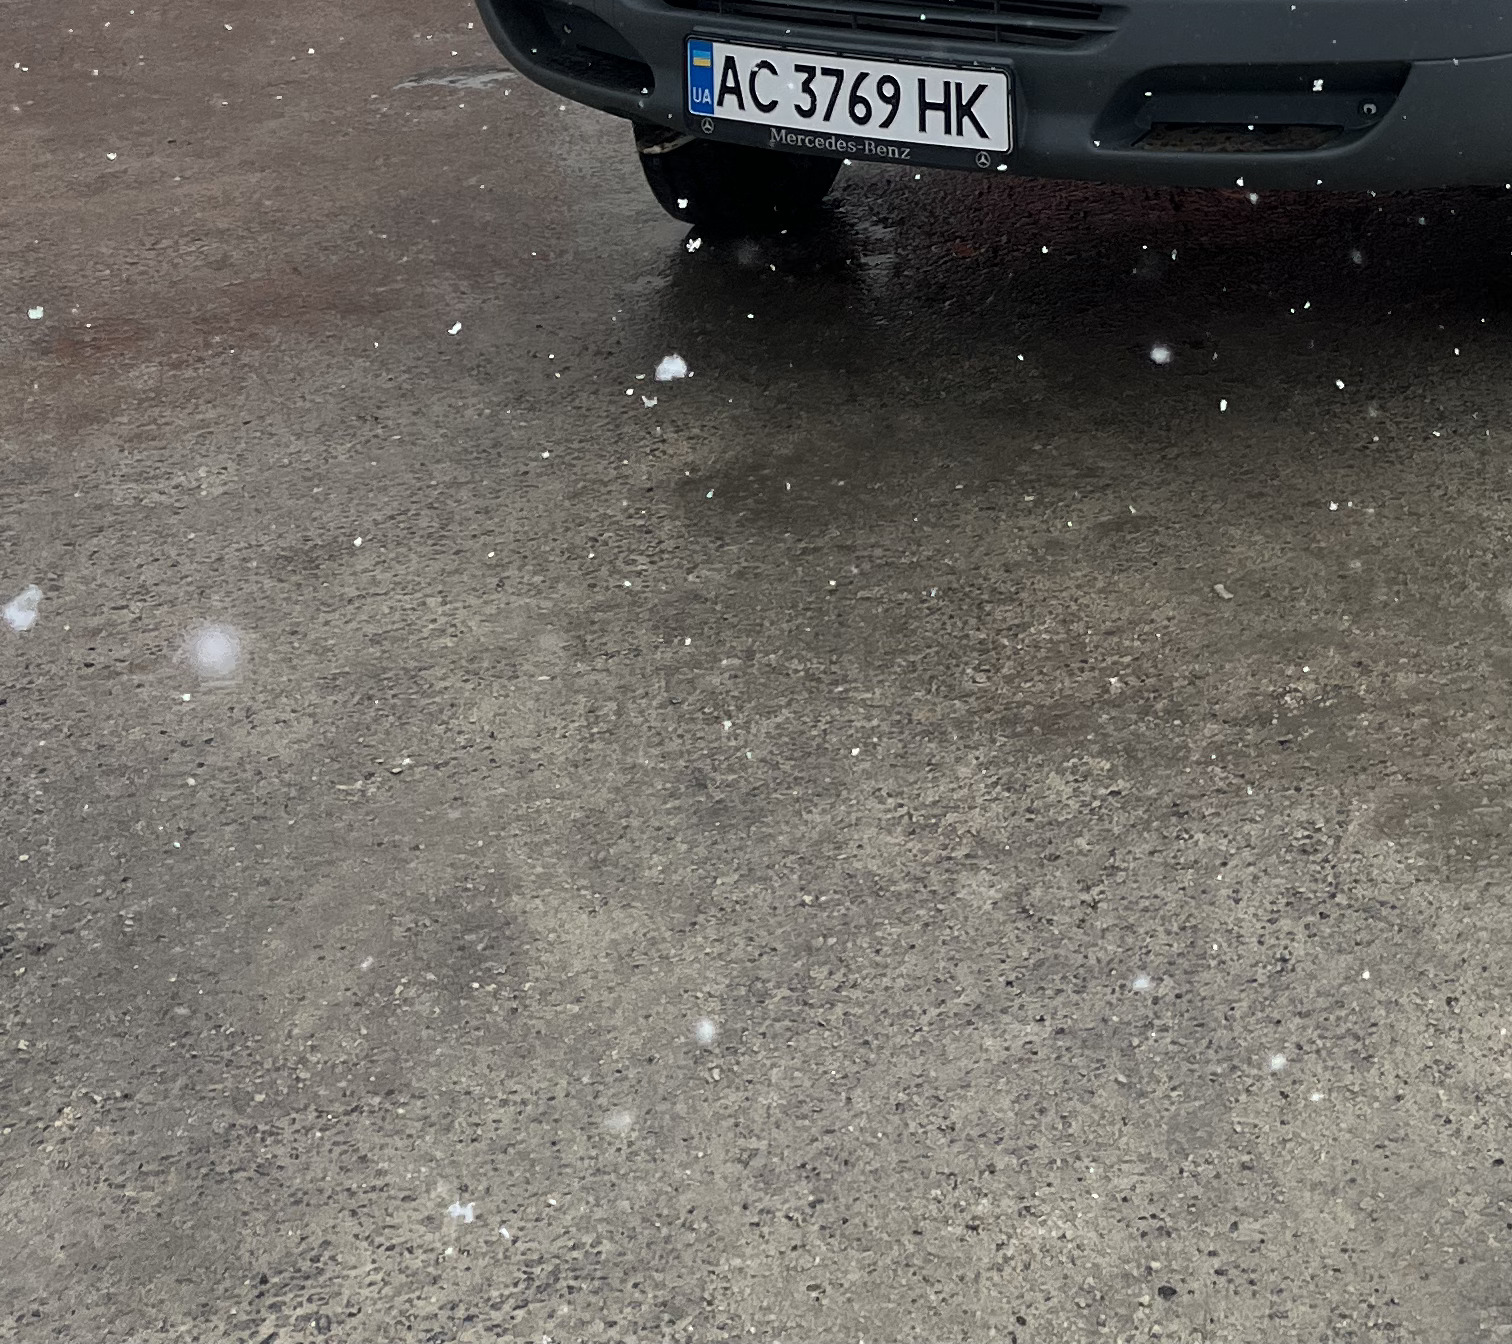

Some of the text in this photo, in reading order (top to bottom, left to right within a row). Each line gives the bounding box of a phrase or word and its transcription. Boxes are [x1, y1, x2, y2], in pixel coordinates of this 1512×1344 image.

[692, 87, 711, 105] UA
[717, 55, 990, 139] AC 3769 HK
[769, 127, 911, 160] Mercedes-Benz
